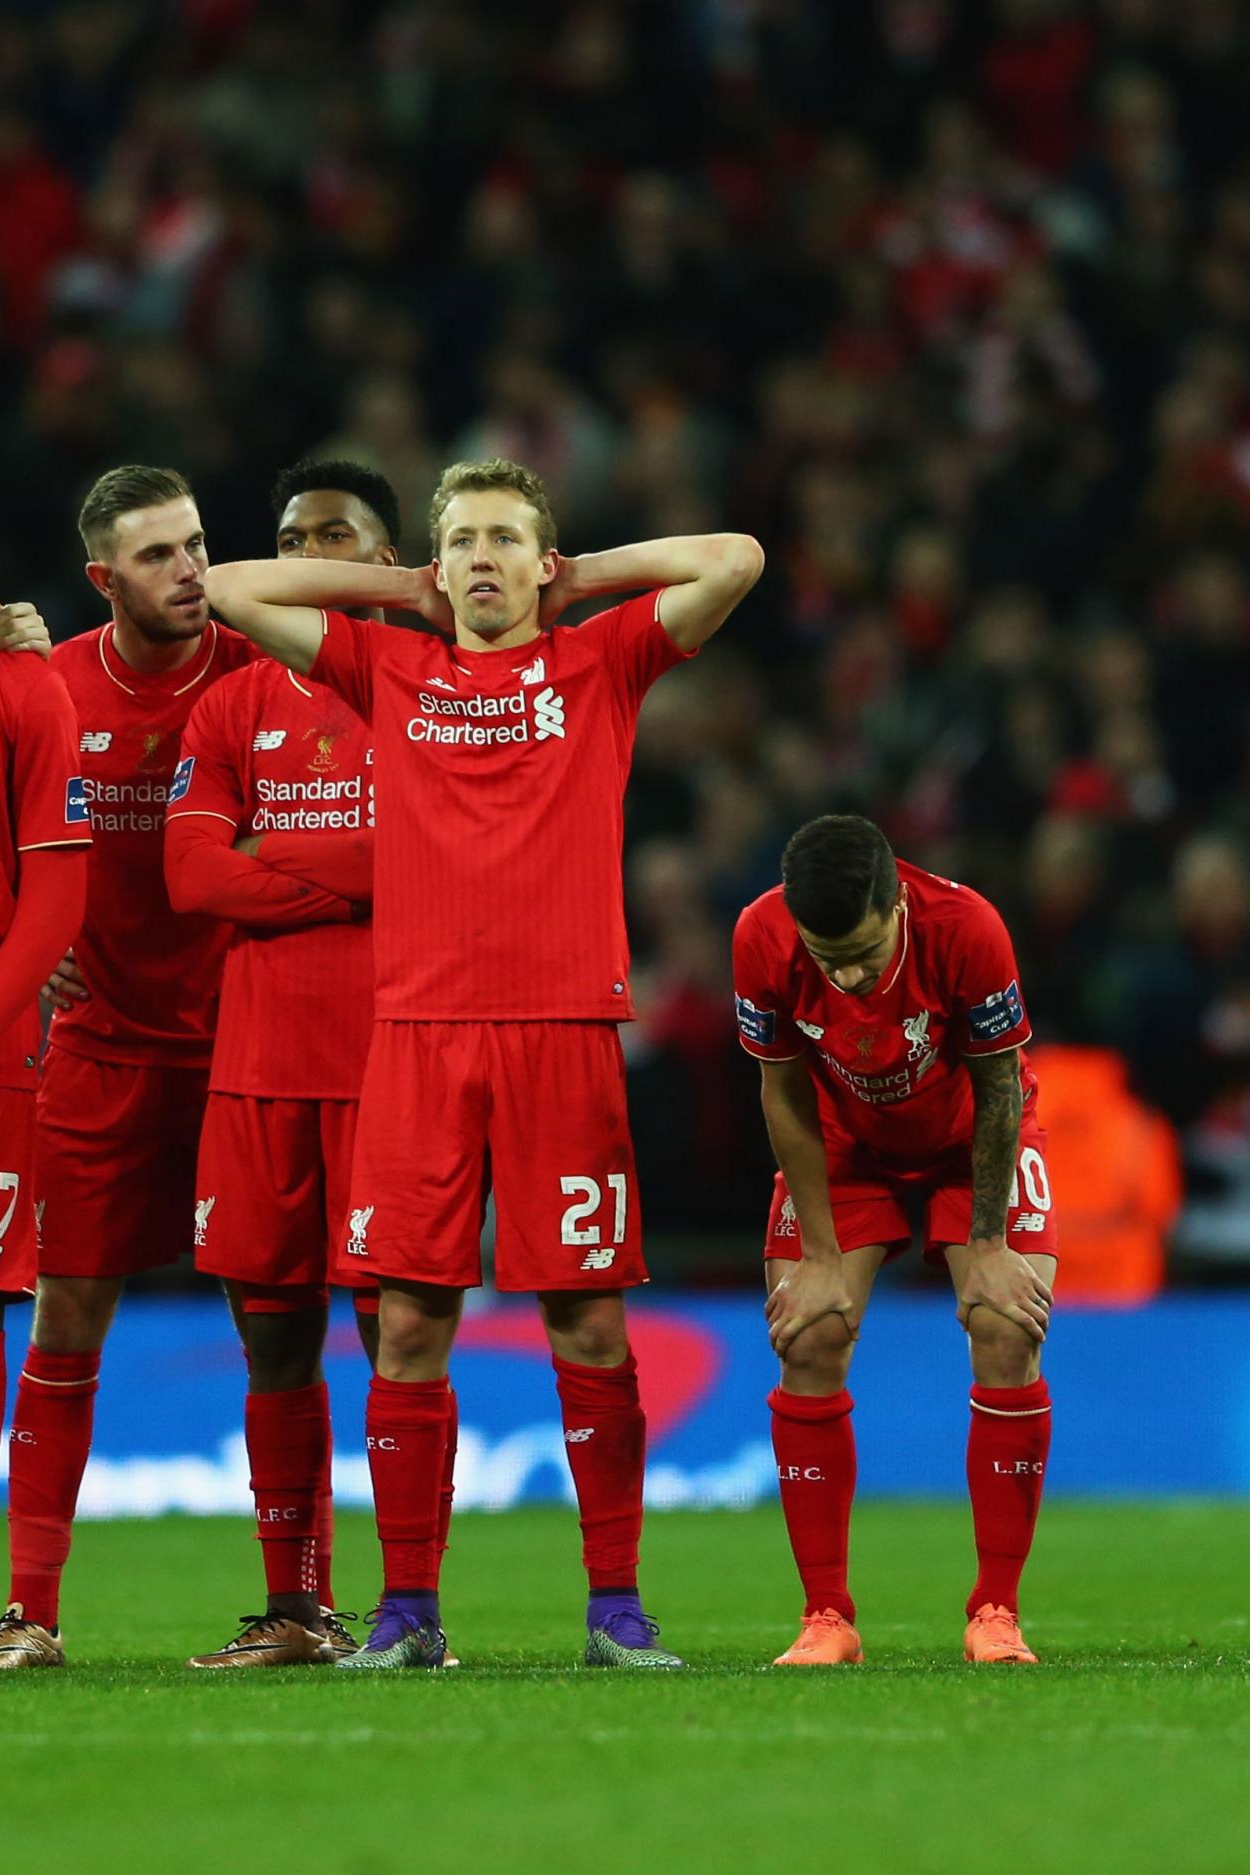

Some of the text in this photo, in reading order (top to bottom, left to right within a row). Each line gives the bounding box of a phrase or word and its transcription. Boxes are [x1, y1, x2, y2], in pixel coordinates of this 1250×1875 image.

[418, 690, 526, 717] Standard
[407, 720, 528, 744] Chartered
[82, 779, 167, 802] Standa
[257, 775, 360, 802] Standard
[90, 808, 163, 831] harter
[252, 804, 360, 831] Chartered
[821, 1050, 910, 1088] tandard
[560, 1173, 627, 1246] 21
